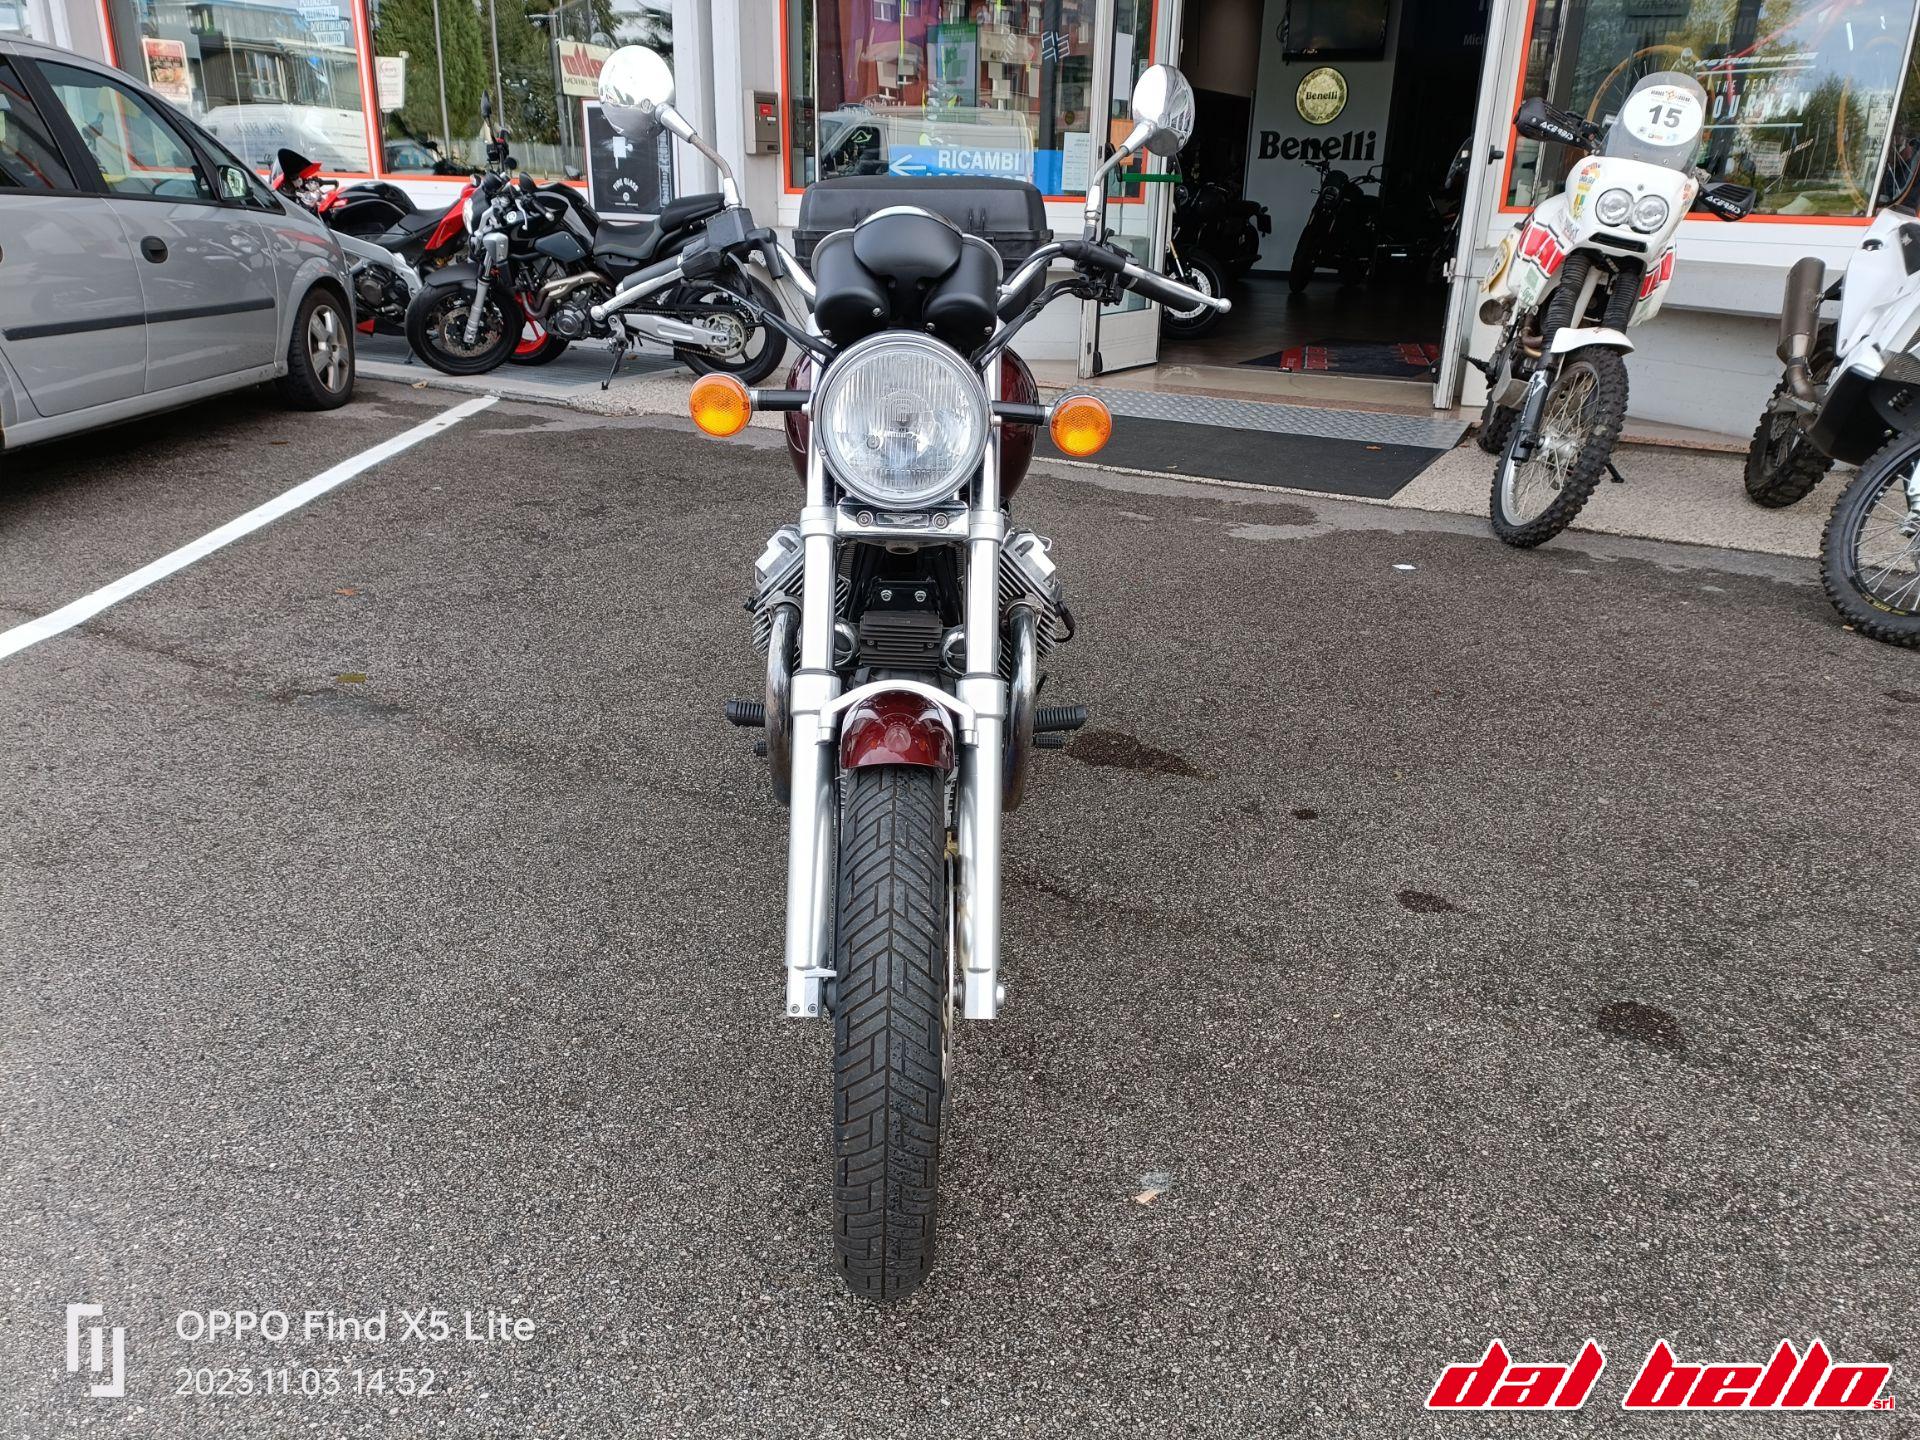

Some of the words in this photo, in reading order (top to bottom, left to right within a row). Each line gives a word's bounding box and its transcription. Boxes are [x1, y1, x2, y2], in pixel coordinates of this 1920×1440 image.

[1306, 91, 1338, 100] Benelli
[1716, 79, 1738, 93] THE
[1744, 77, 1799, 92] PERFECT
[1649, 104, 1683, 128] 15
[1713, 92, 1811, 119] OURNEY
[1540, 121, 1574, 141] ACERBIS
[1258, 130, 1377, 161] Benelli
[938, 149, 1020, 171] RICAMBI
[1705, 195, 1741, 214] ACERBIS
